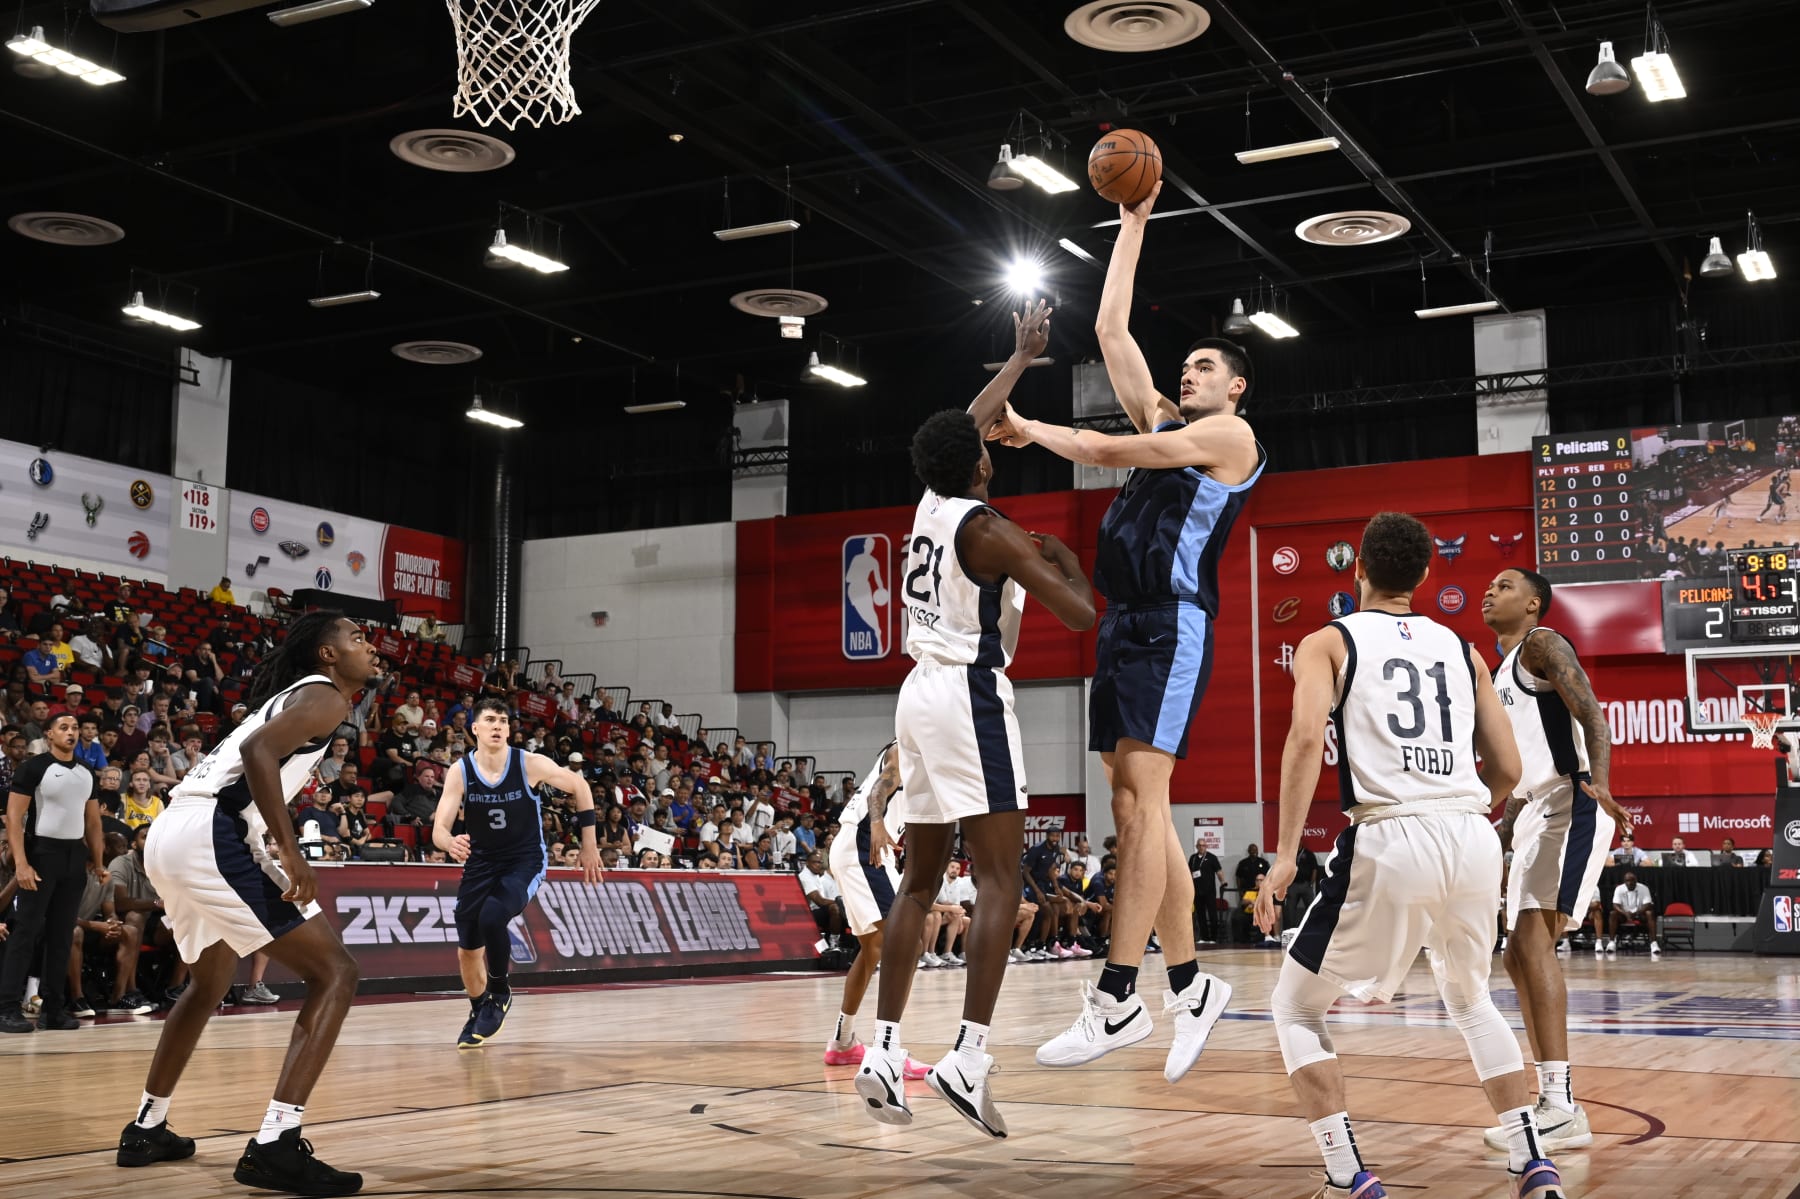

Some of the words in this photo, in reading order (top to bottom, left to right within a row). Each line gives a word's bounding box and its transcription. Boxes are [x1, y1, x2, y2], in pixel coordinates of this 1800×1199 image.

[1542, 444, 1550, 456] 2
[1556, 440, 1609, 456] Pelicans
[1617, 438, 1626, 449] 0
[1564, 466, 1580, 474] PTS
[1588, 464, 1605, 472] REB
[1614, 462, 1630, 470] FLS
[1540, 480, 1556, 491] 12
[1568, 478, 1576, 489] 0
[1592, 475, 1601, 487] 0
[1618, 473, 1626, 484] 0
[191, 490, 209, 506] 118
[1541, 497, 1556, 509] 21
[1568, 497, 1577, 508] 0
[1593, 494, 1602, 506] 0
[1620, 492, 1628, 504] 0
[189, 513, 208, 530] 119
[1541, 516, 1557, 528] 24
[1569, 513, 1578, 525] 2
[1594, 512, 1603, 524] 0
[1620, 510, 1628, 521] 0
[1542, 532, 1558, 544] 30
[1570, 532, 1578, 544] 0
[1595, 530, 1603, 542] 0
[1621, 528, 1630, 540] 0
[1544, 550, 1558, 562] 31
[1571, 550, 1579, 561] 0
[1596, 549, 1605, 560] 0
[1623, 546, 1631, 558] 0
[1747, 554, 1787, 572] 9:18
[395, 552, 440, 578] TOMORROW'S
[906, 536, 944, 608] 21
[394, 572, 416, 593] STARS
[417, 576, 434, 596] PLAY
[435, 579, 452, 600] HERE
[1680, 588, 1733, 604] PELICANS
[1750, 605, 1794, 615] TISSOT
[1706, 607, 1723, 638] 2
[850, 631, 872, 650] NBA
[1383, 658, 1453, 742] 31
[1401, 746, 1453, 776] FORD
[468, 790, 522, 804] GRIZZLIES
[488, 809, 507, 829] 3
[1703, 815, 1771, 829] Microsoft
[537, 881, 671, 957] SUMMER
[653, 882, 760, 951] LEAGUE
